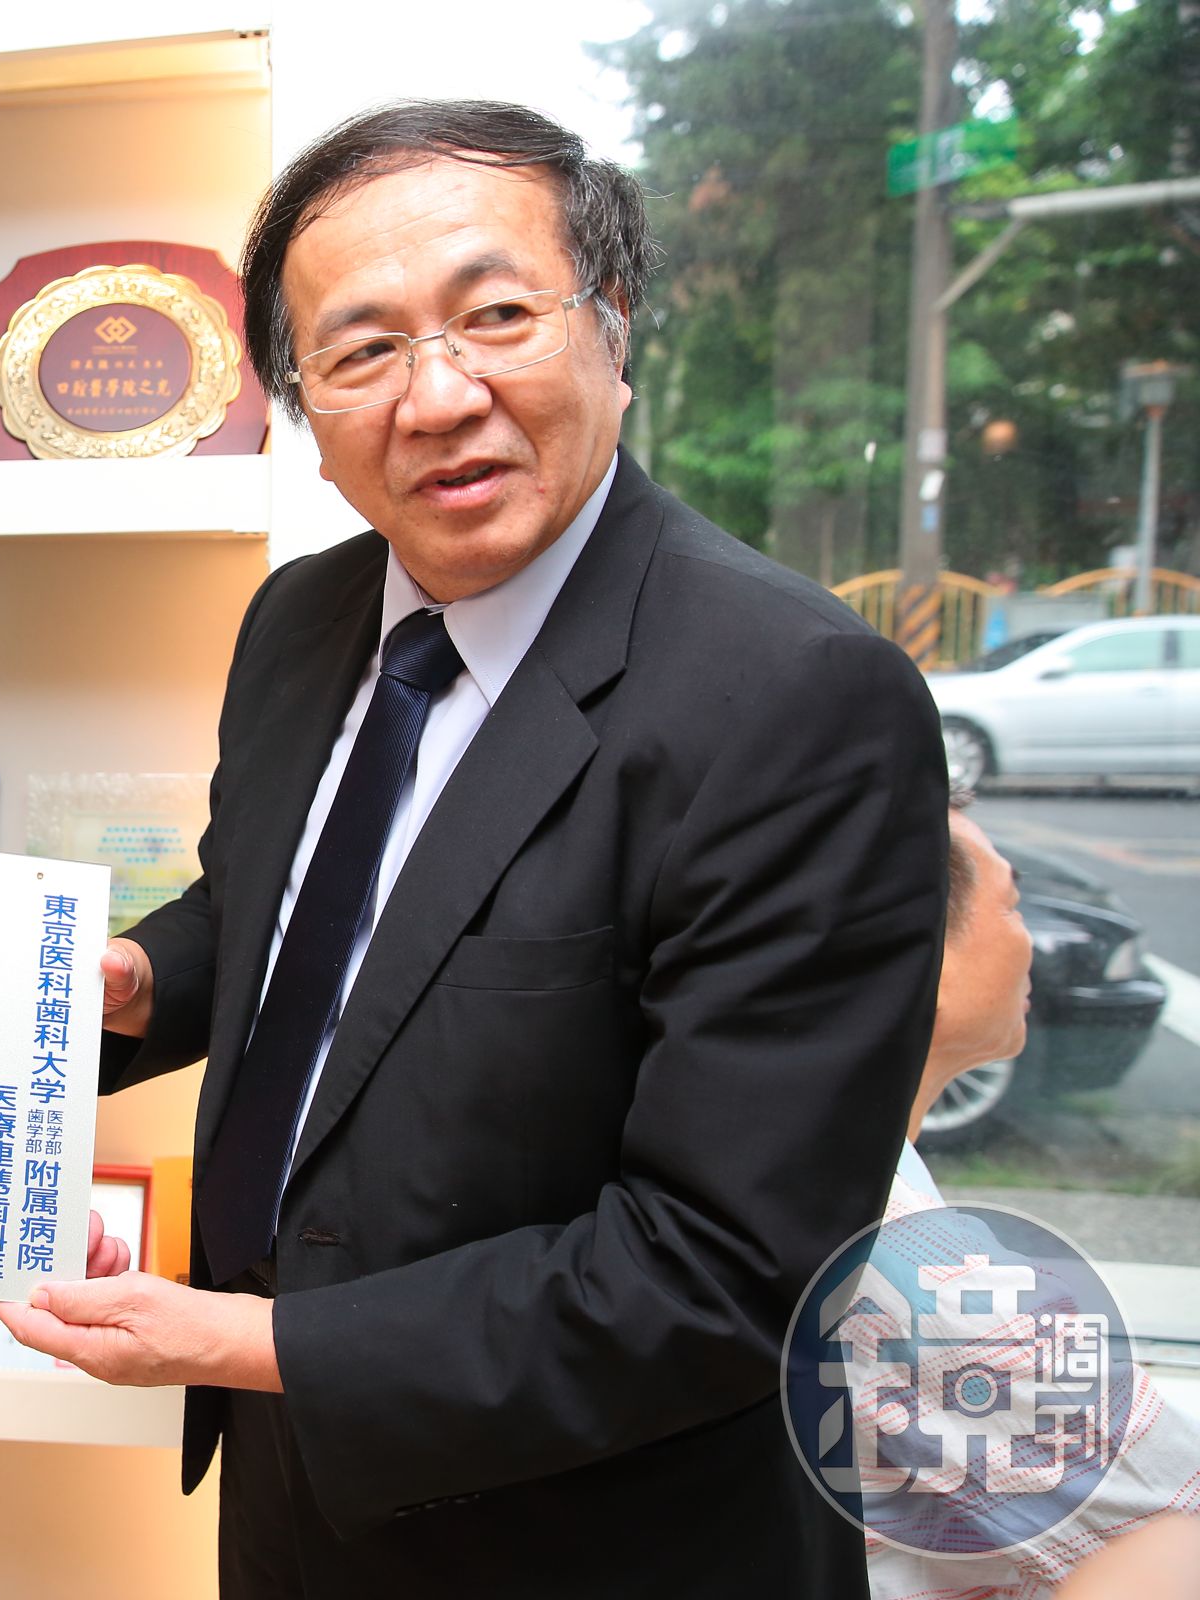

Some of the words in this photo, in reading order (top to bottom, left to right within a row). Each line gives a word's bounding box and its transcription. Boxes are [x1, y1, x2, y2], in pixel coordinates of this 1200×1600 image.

[30, 894, 79, 1104] 東京医科歯科大学
[25, 1108, 44, 1154] 歯学部
[45, 1109, 64, 1156] 医学部
[17, 1159, 62, 1273] 附属病院
